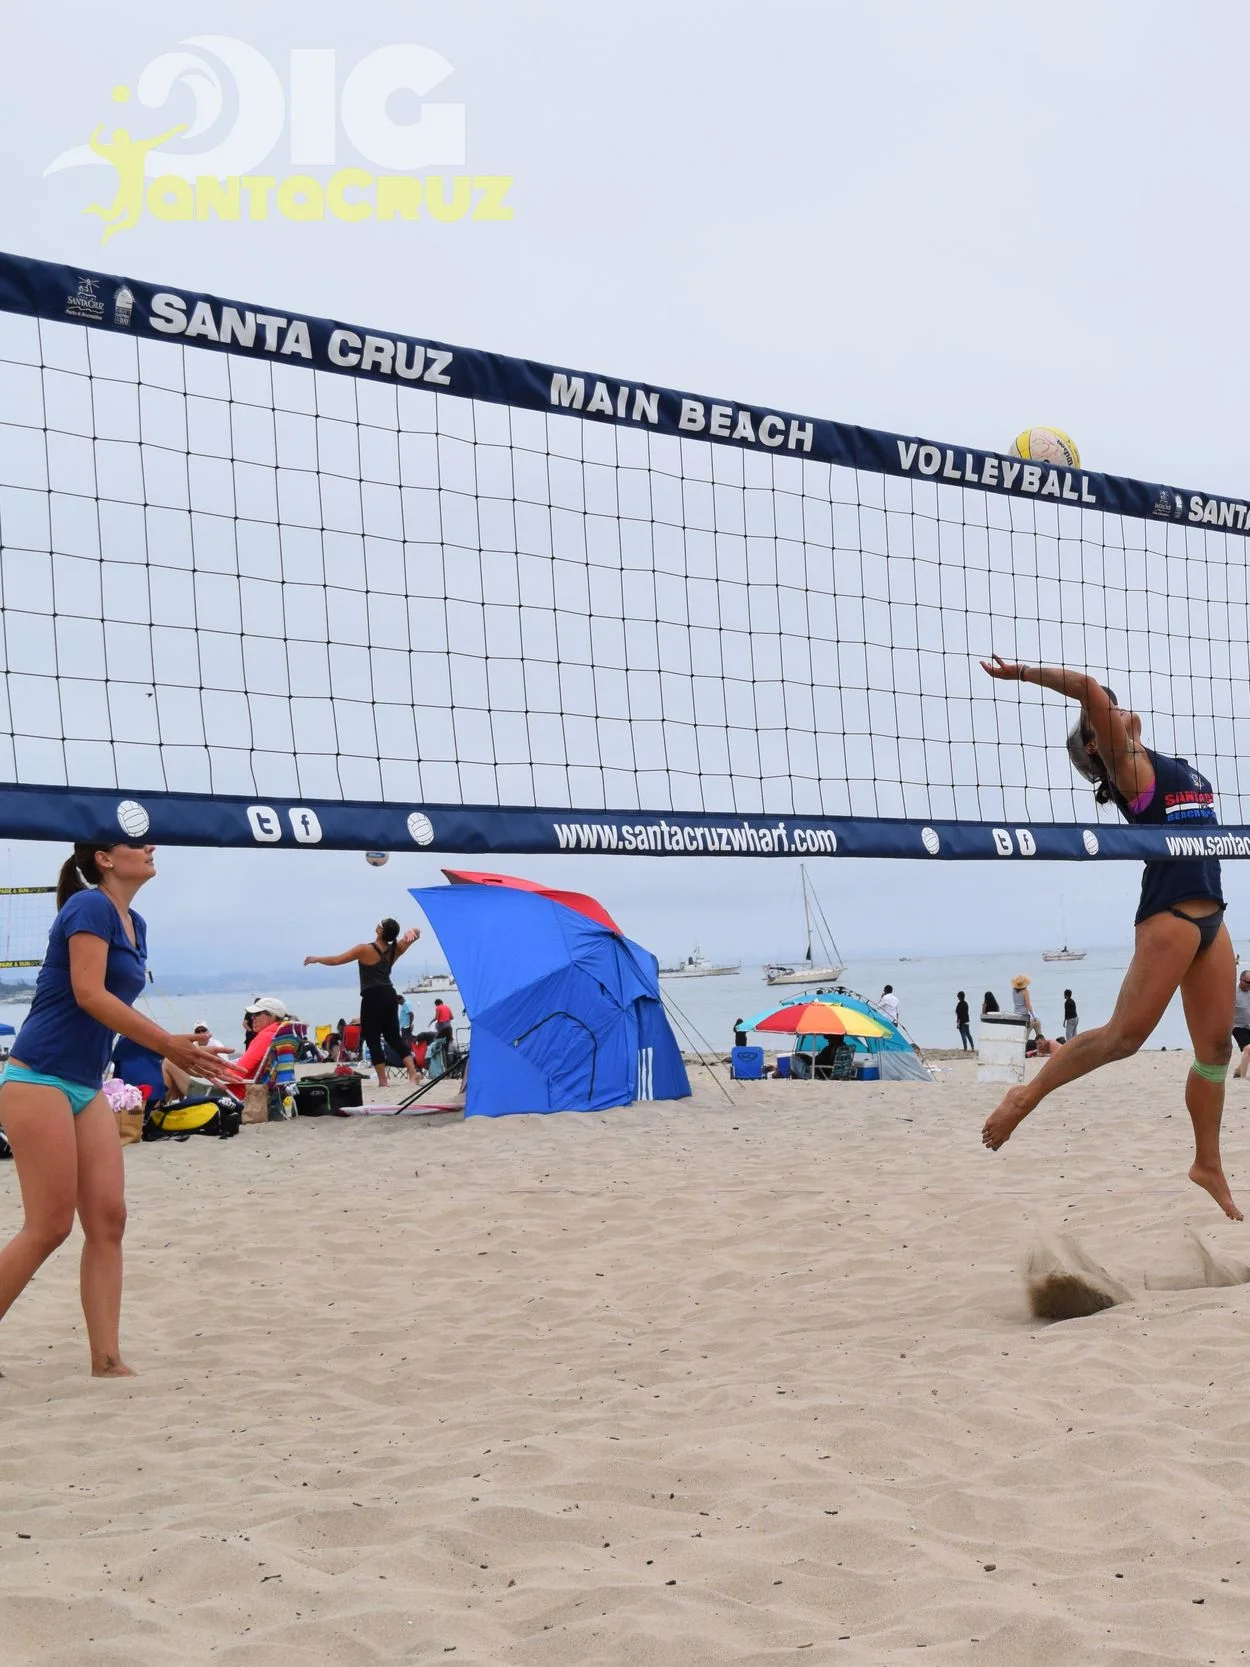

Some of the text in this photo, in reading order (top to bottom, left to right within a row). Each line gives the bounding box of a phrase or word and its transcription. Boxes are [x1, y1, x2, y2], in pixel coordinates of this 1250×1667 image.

[150, 293, 1097, 503] SANTA CRUZ MAIN BEACH VOLLEYBALL
[553, 820, 838, 853] www.santacruzwharf.com
